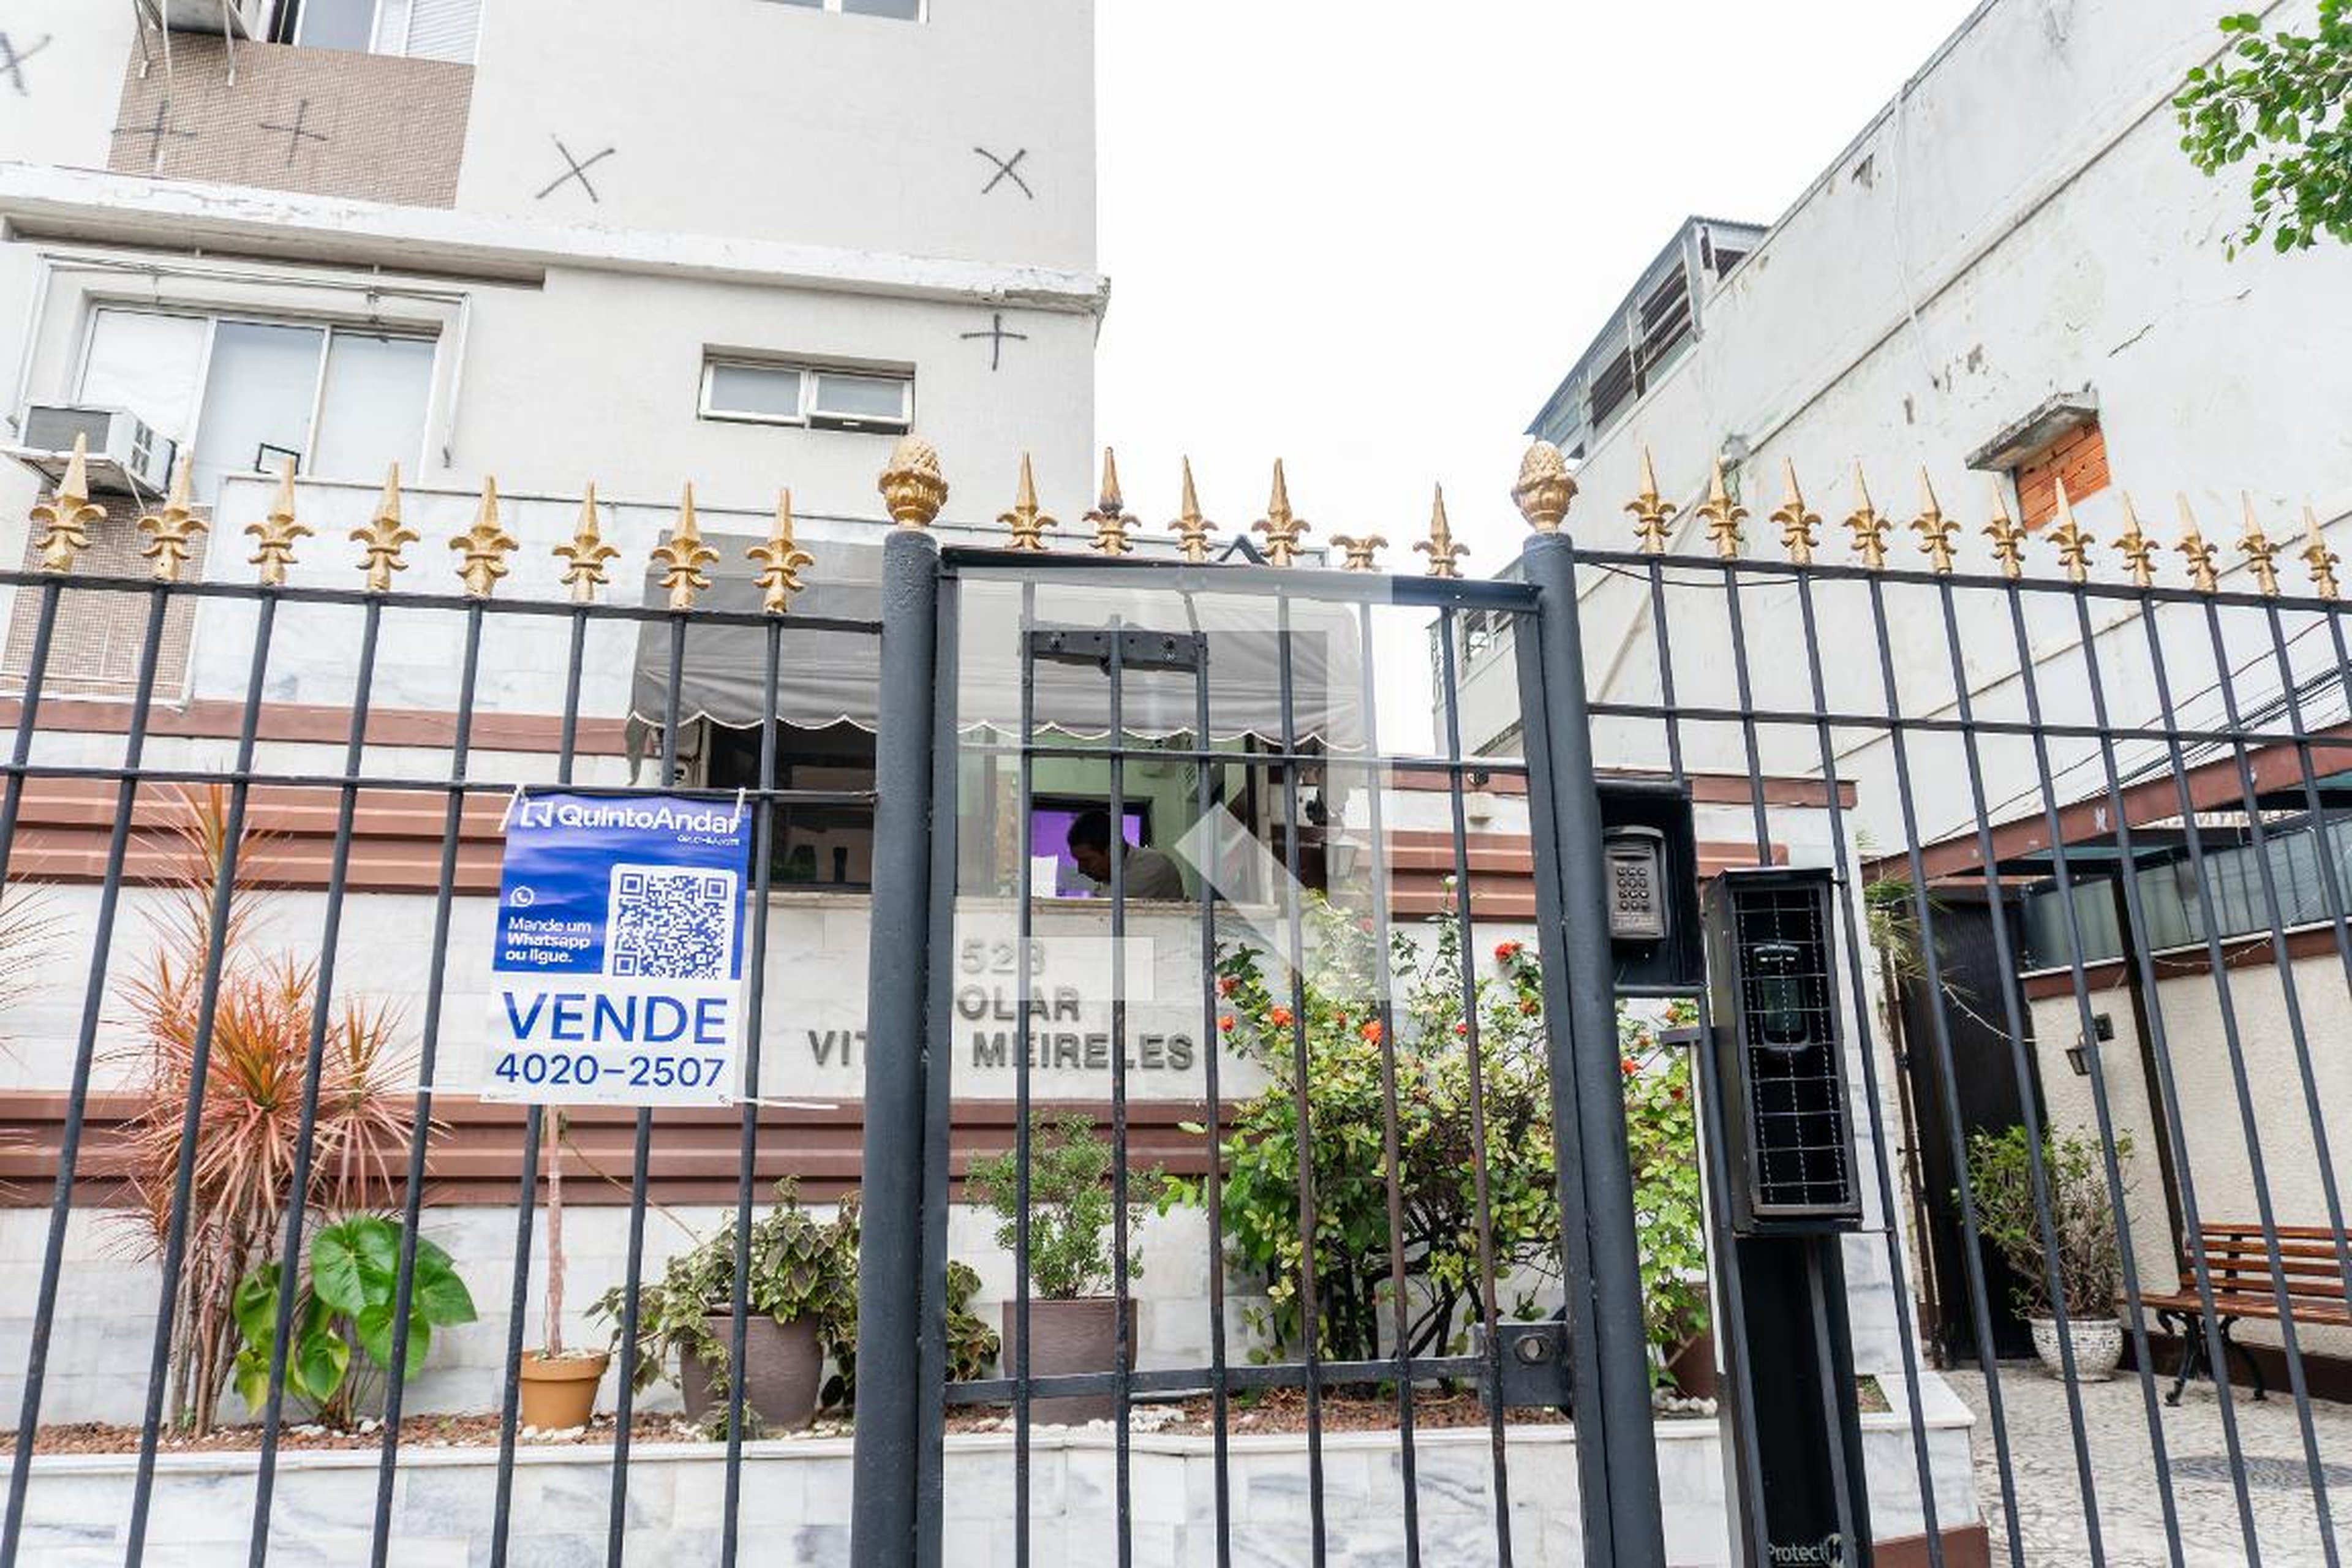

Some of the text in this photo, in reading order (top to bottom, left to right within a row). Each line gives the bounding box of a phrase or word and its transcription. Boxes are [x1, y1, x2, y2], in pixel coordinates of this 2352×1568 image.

[557, 804, 741, 834] QuintoAndar
[508, 917, 591, 933] Mande um
[507, 932, 590, 950] Whatsapp
[505, 948, 573, 965] ou ligue.
[956, 984, 1080, 1021] OLAR
[503, 992, 728, 1044] VENDE
[495, 1053, 725, 1088] 4020-2507
